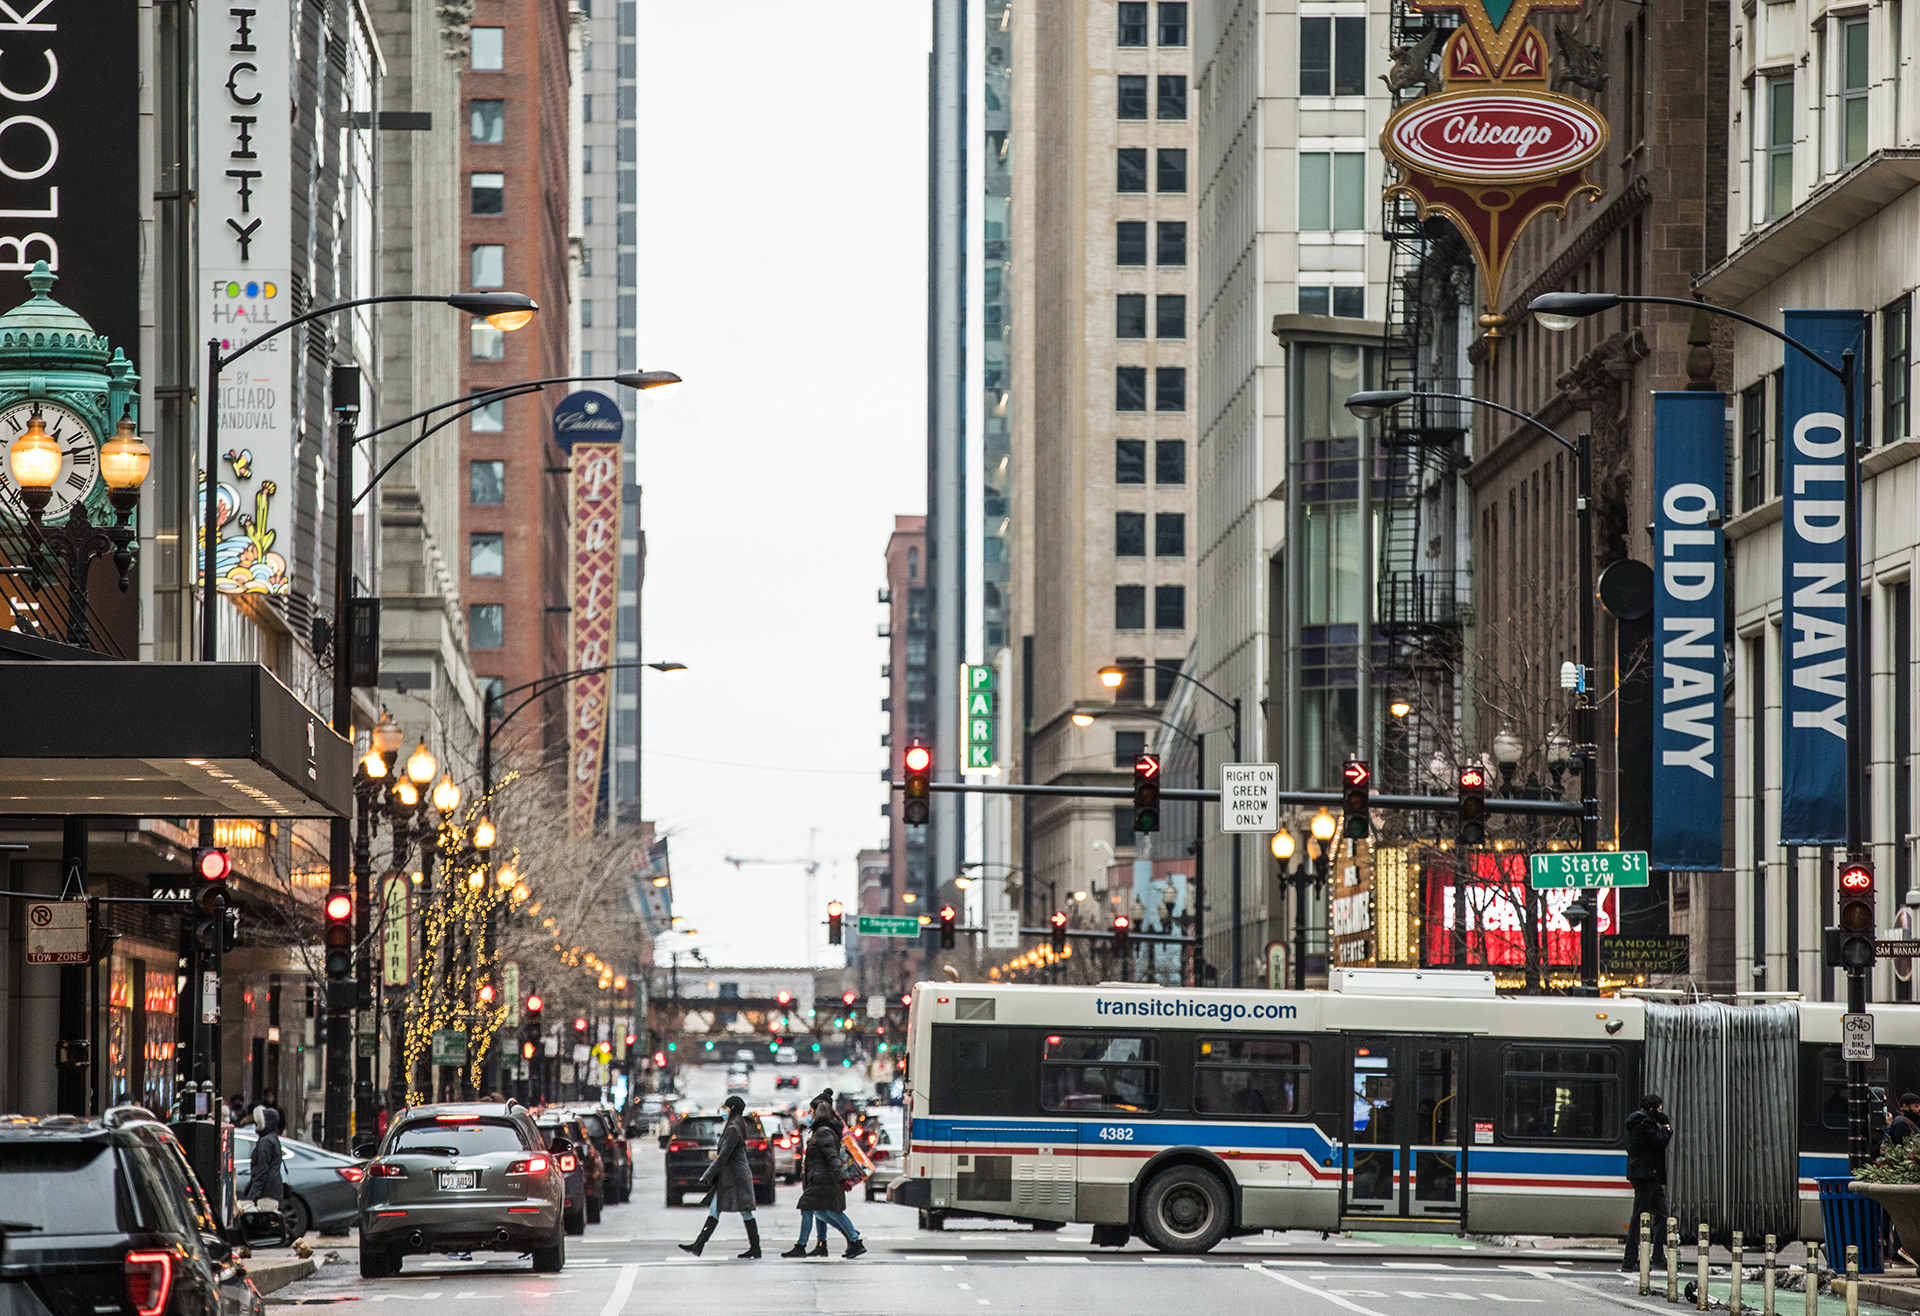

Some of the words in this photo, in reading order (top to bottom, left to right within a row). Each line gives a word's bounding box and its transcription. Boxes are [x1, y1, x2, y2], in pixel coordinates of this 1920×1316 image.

[225, 0, 263, 262] ICITY
[1443, 115, 1553, 158] Chicago
[212, 280, 278, 299] FOOD
[212, 304, 278, 324] HALL
[236, 371, 250, 385] BY
[218, 412, 277, 430] ANDOVAL
[555, 412, 621, 434] Cadillac
[1793, 412, 1846, 545] OLD
[1662, 482, 1717, 602] OLD
[576, 457, 614, 782] Palace
[1793, 562, 1847, 741] NAVY
[1662, 617, 1716, 779] NAVY
[970, 668, 990, 767] PARK
[1226, 771, 1256, 782] RIGHT
[1259, 771, 1274, 782] ON
[1232, 785, 1267, 797] GREEN
[1232, 800, 1269, 811] ARROW
[1236, 814, 1264, 826] ONLY
[1538, 856, 1549, 874] N
[1561, 854, 1609, 873] State
[1622, 853, 1641, 872] St
[1585, 872, 1614, 887] E/W
[1604, 940, 1685, 950] RANDOLPH
[1876, 947, 1891, 955] SAM
[31, 954, 51, 962] TOW
[57, 953, 83, 961] ZONE
[1612, 951, 1677, 960] THEATRE
[1610, 961, 1677, 970] DISTRICT
[1096, 998, 1297, 1022] transitchicago.com
[1099, 1127, 1134, 1141] 4382
